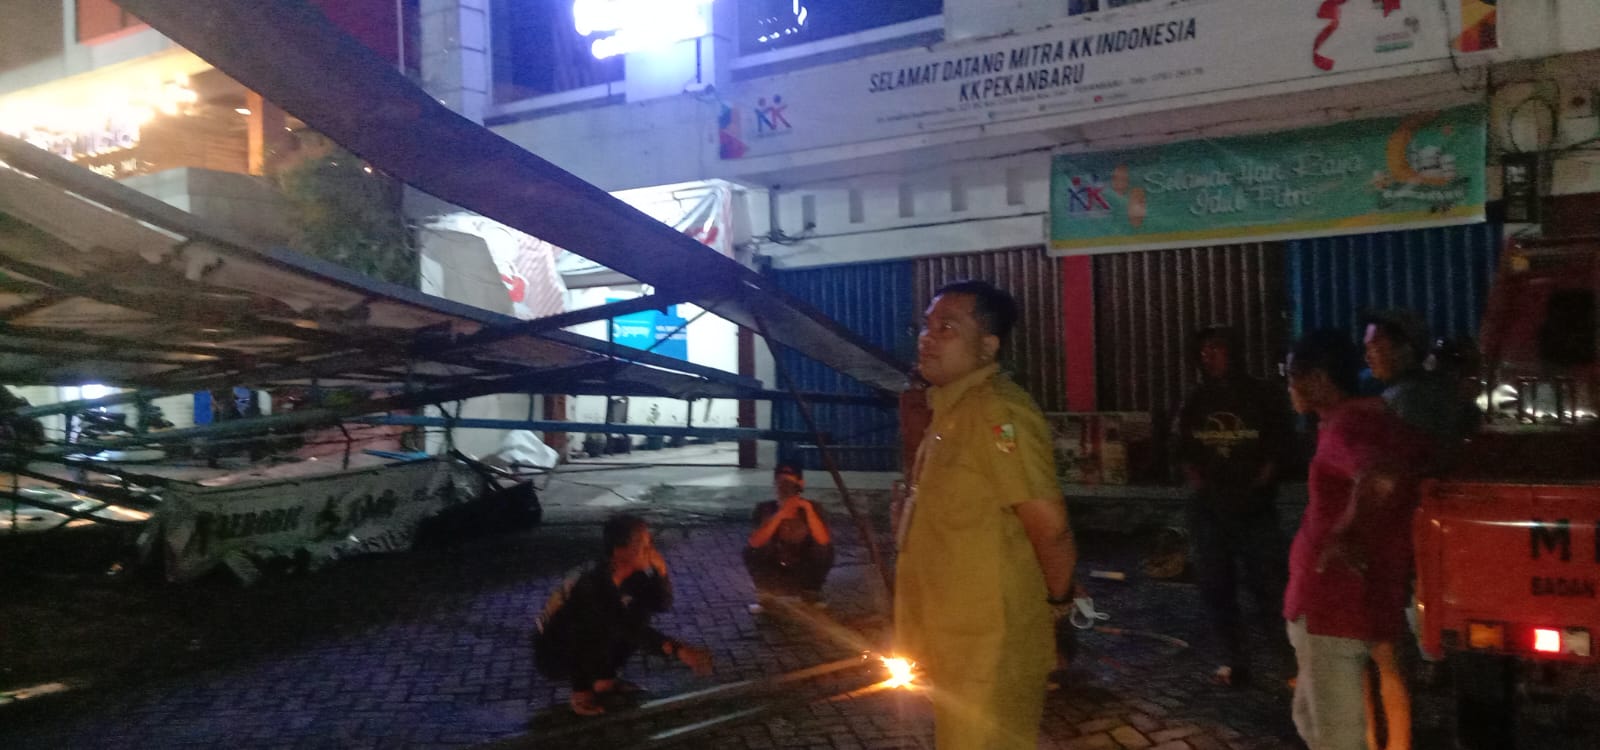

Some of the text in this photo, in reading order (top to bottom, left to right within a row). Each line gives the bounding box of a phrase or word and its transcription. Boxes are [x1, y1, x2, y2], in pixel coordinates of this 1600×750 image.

[869, 61, 939, 94] SELAMAT
[942, 51, 1004, 81] DATANG
[1009, 40, 1065, 71] MITRA
[1096, 18, 1198, 56] INDONESIA
